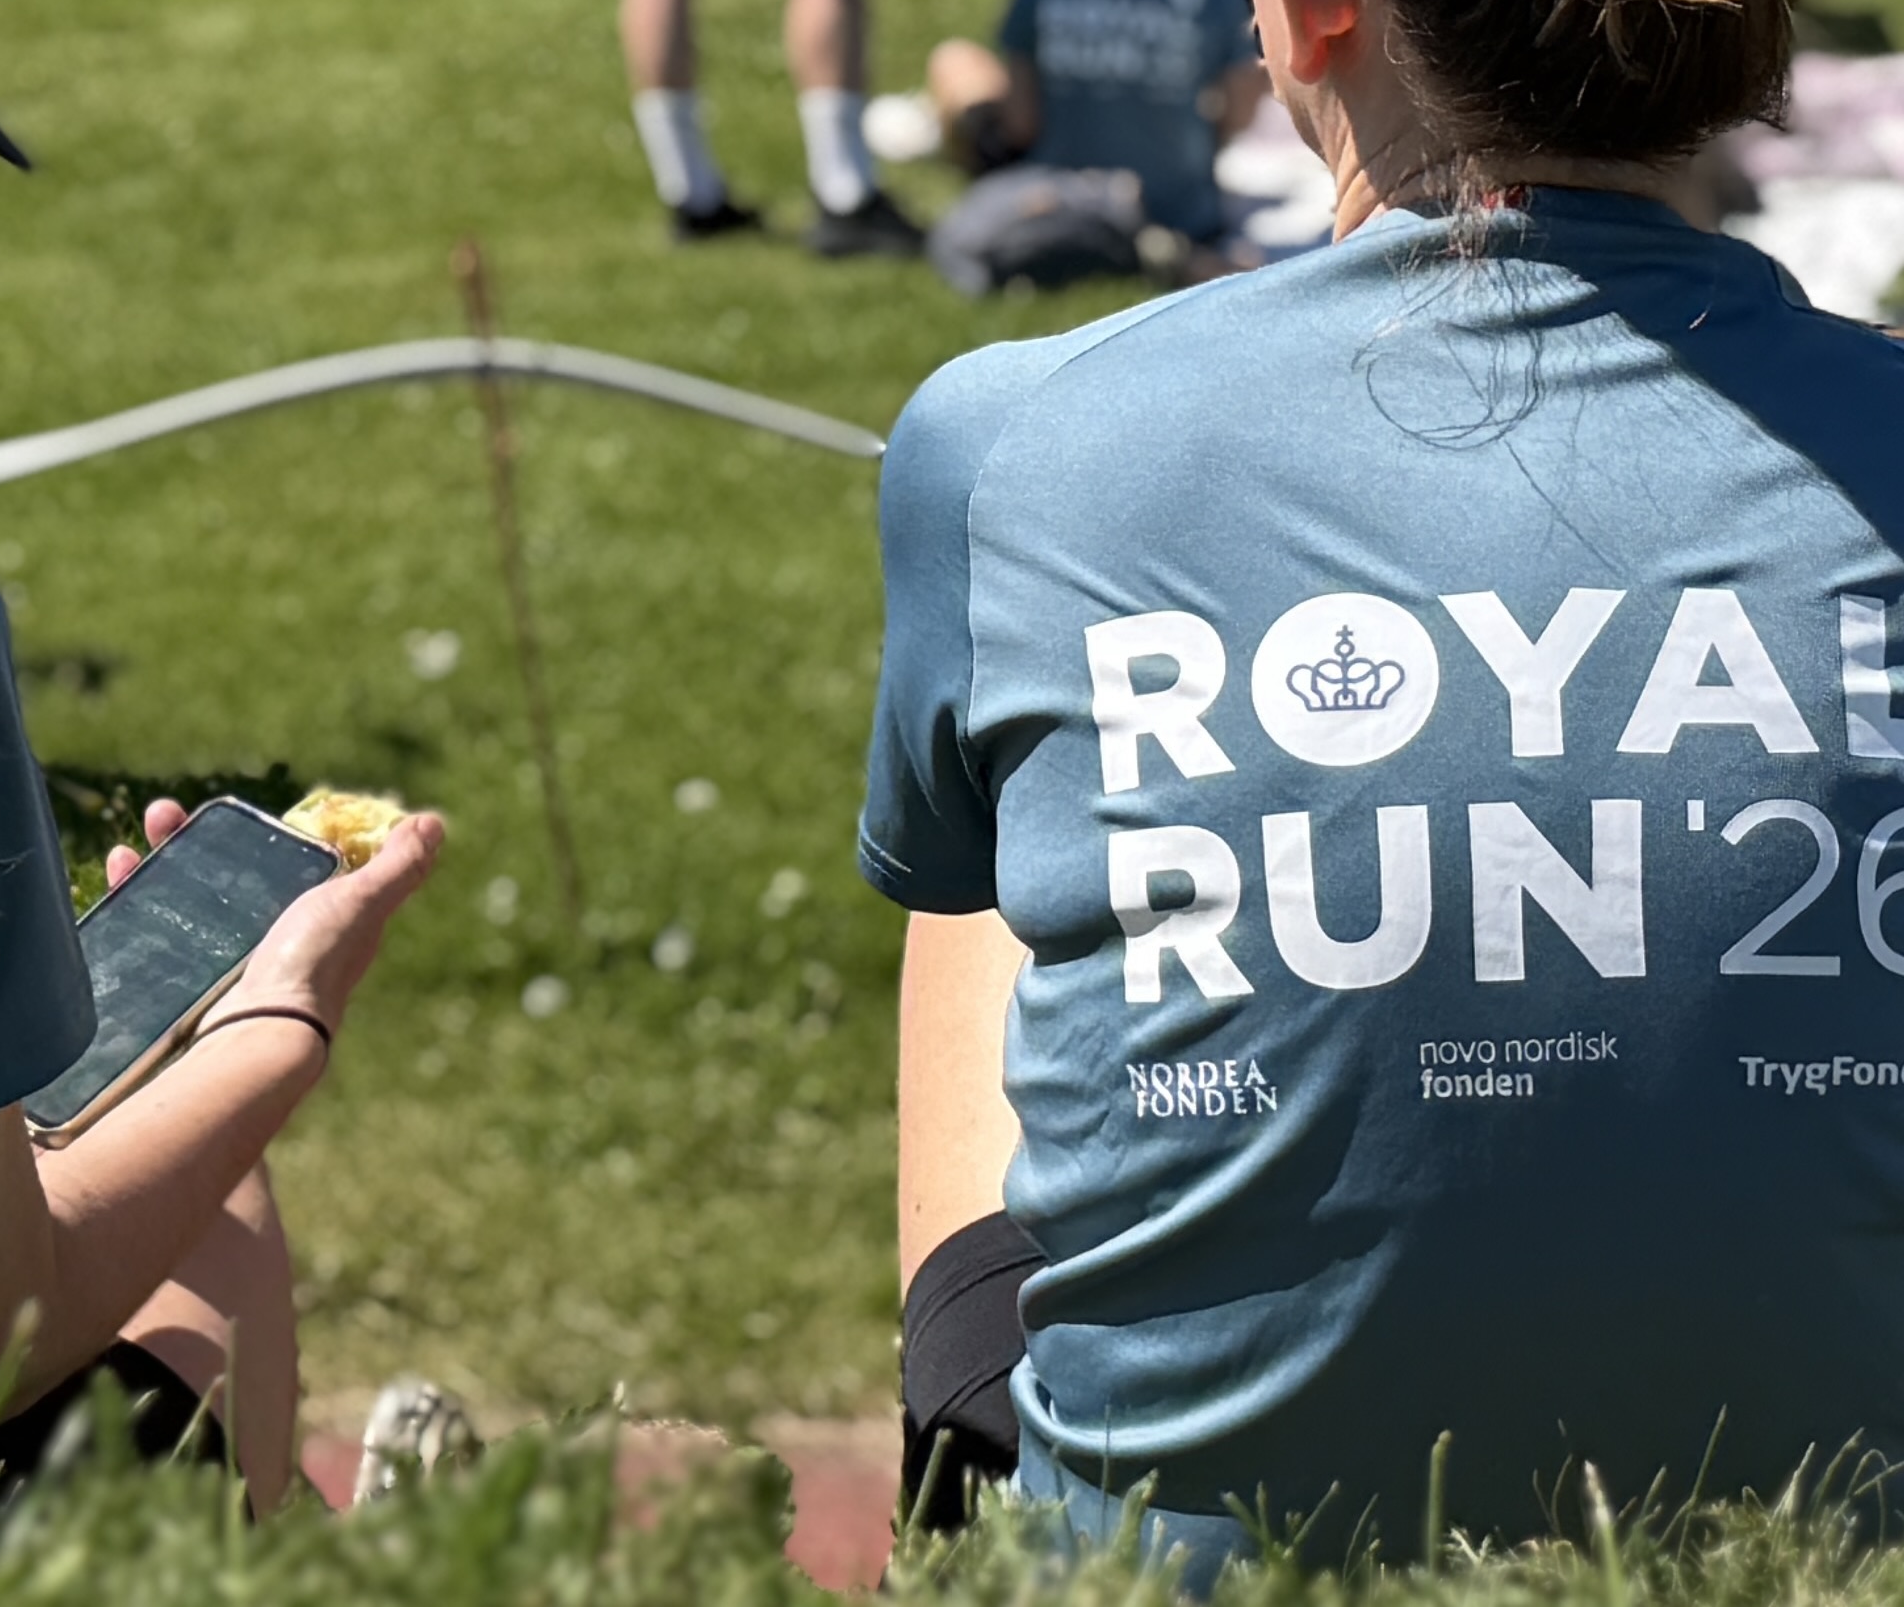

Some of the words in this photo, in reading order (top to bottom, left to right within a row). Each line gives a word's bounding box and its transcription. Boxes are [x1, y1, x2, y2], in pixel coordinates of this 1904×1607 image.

[1420, 1040, 1495, 1065] novo
[1506, 1031, 1618, 1062] nordisk
[1125, 1058, 1268, 1091] NORDEA
[1421, 1068, 1534, 1099] fonden
[1136, 1086, 1278, 1118] FONDEN
